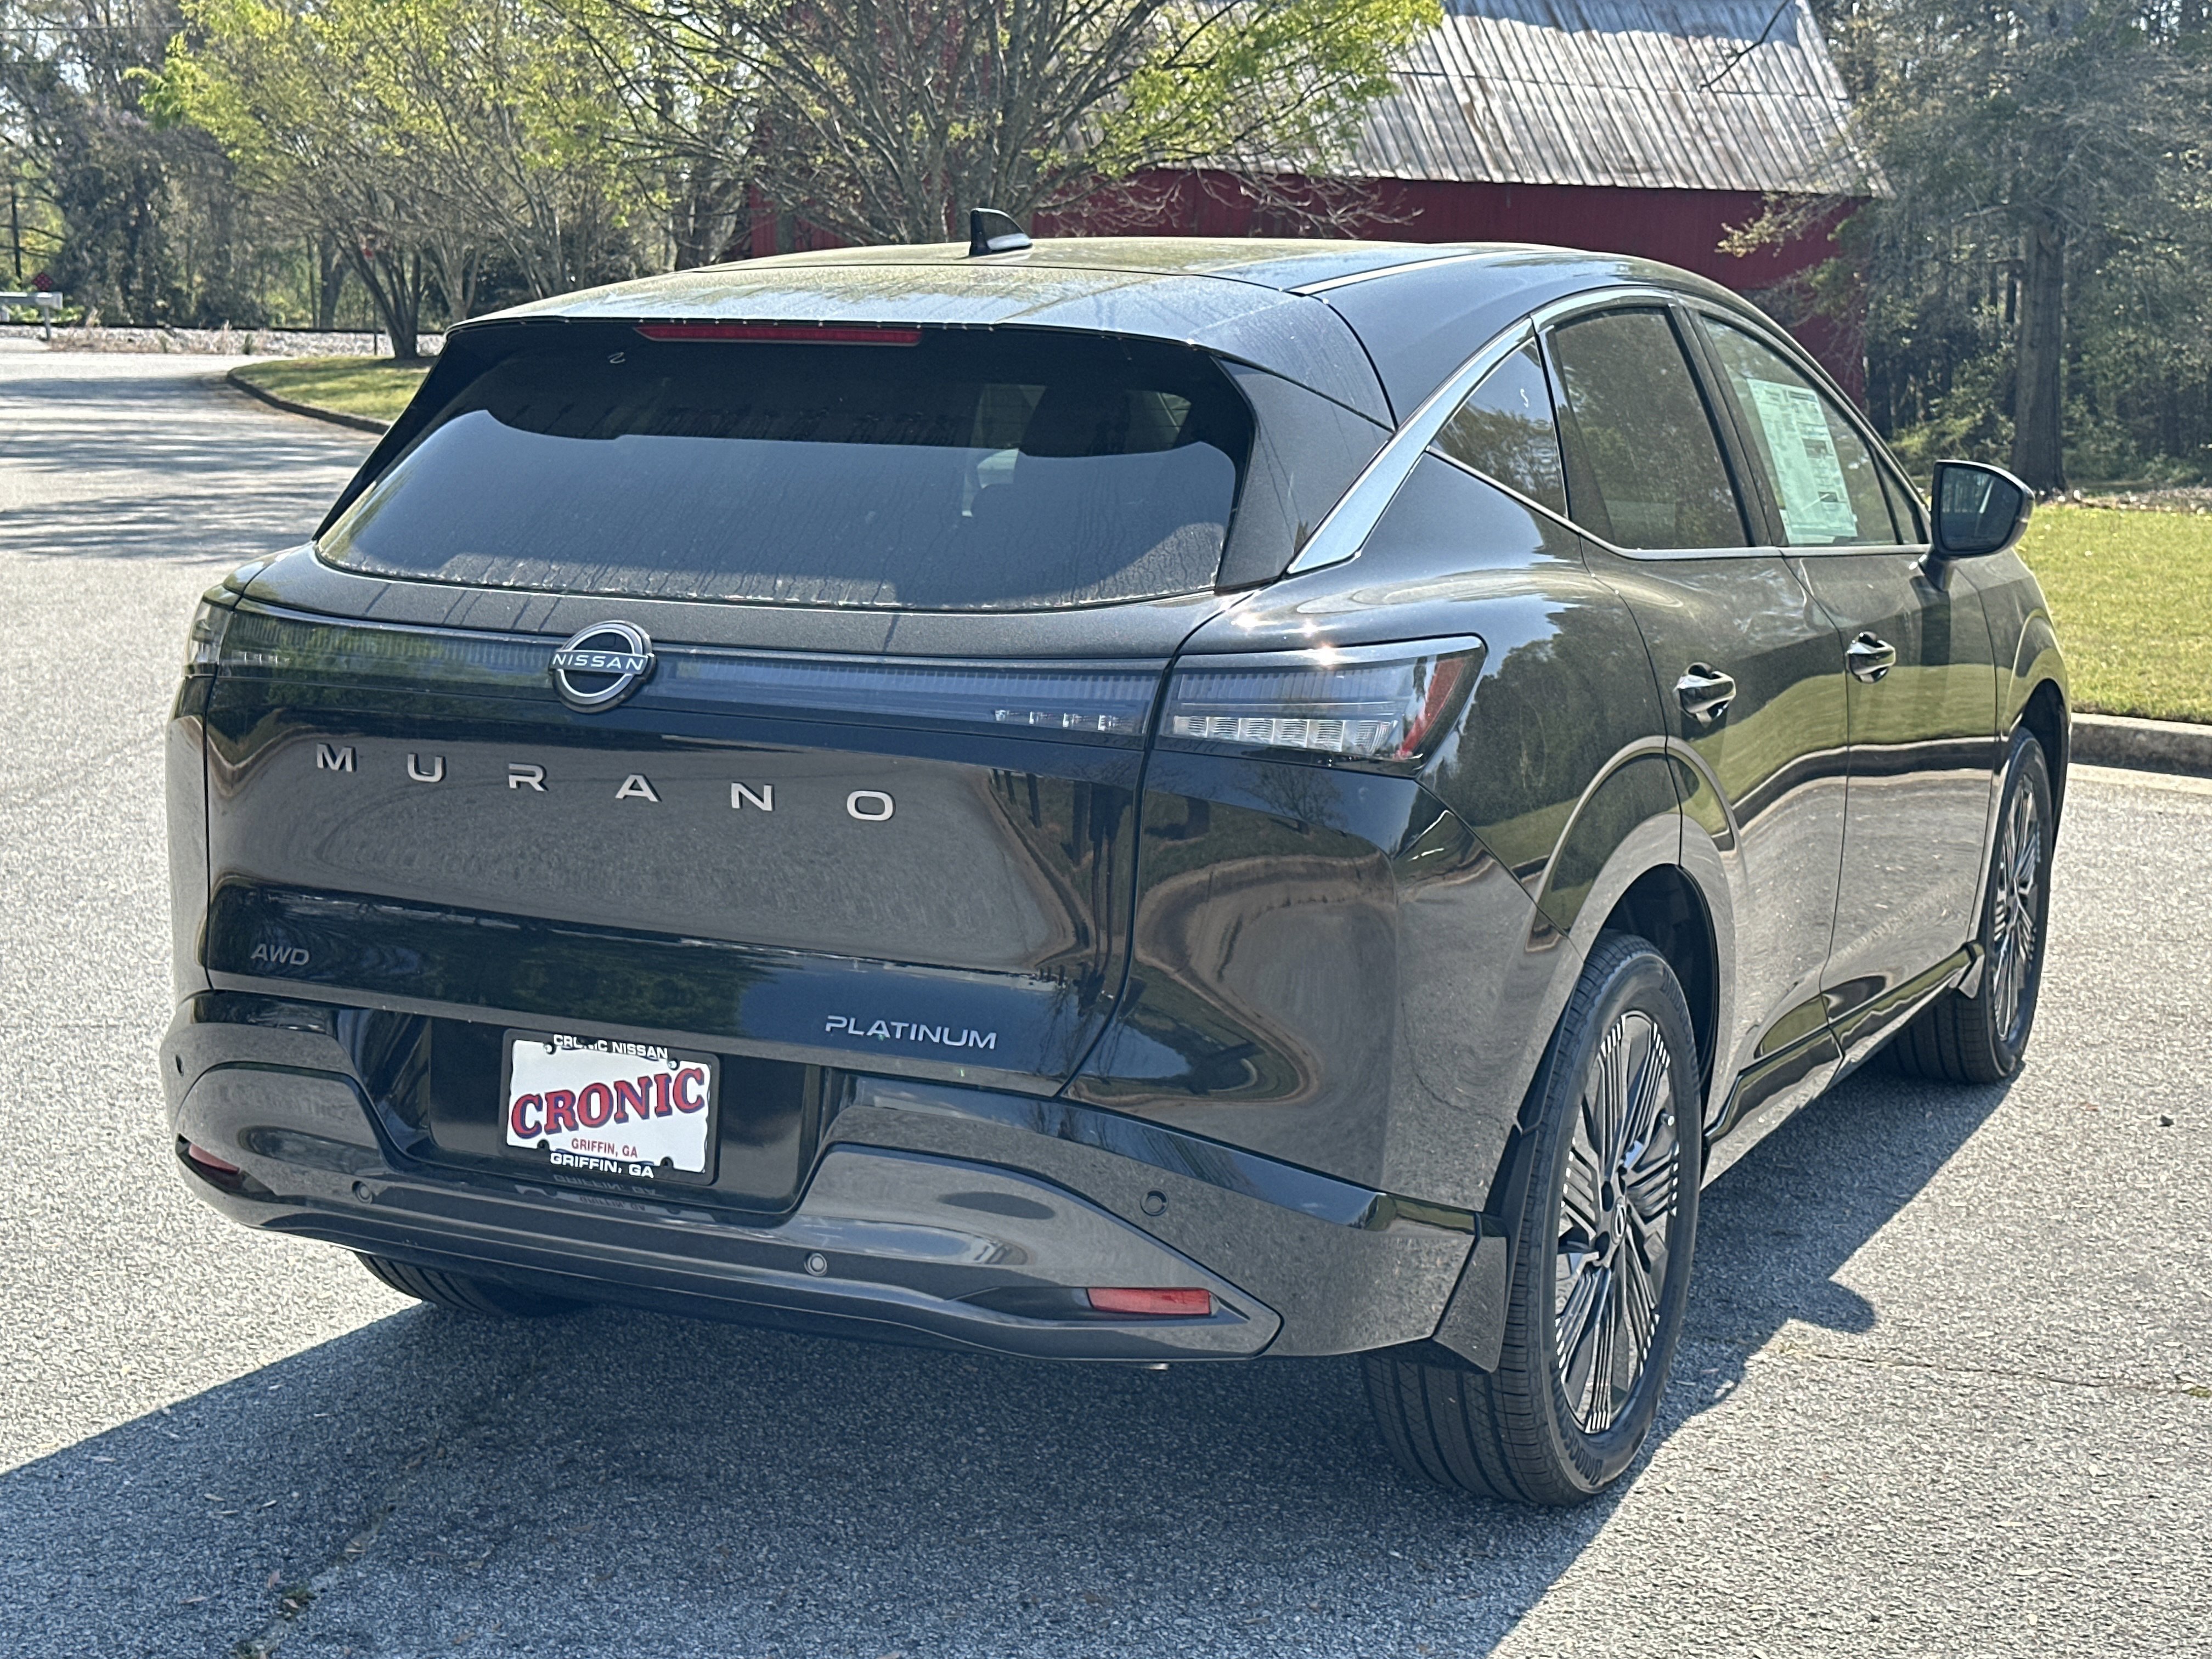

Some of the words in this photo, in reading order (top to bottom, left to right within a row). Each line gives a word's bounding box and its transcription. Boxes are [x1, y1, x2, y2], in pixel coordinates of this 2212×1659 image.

[552, 653, 644, 671] NISSAN
[315, 743, 896, 822] MURANO
[250, 943, 310, 966] AWD
[825, 1015, 997, 1049] PLATINUM
[612, 1041, 668, 1059] NISSAN
[511, 1067, 705, 1139] CRONIC
[571, 1137, 618, 1158] GRIFFIN,
[622, 1144, 638, 1159] GA
[550, 1152, 622, 1174] GRIFFIN,
[628, 1164, 654, 1179] GA
